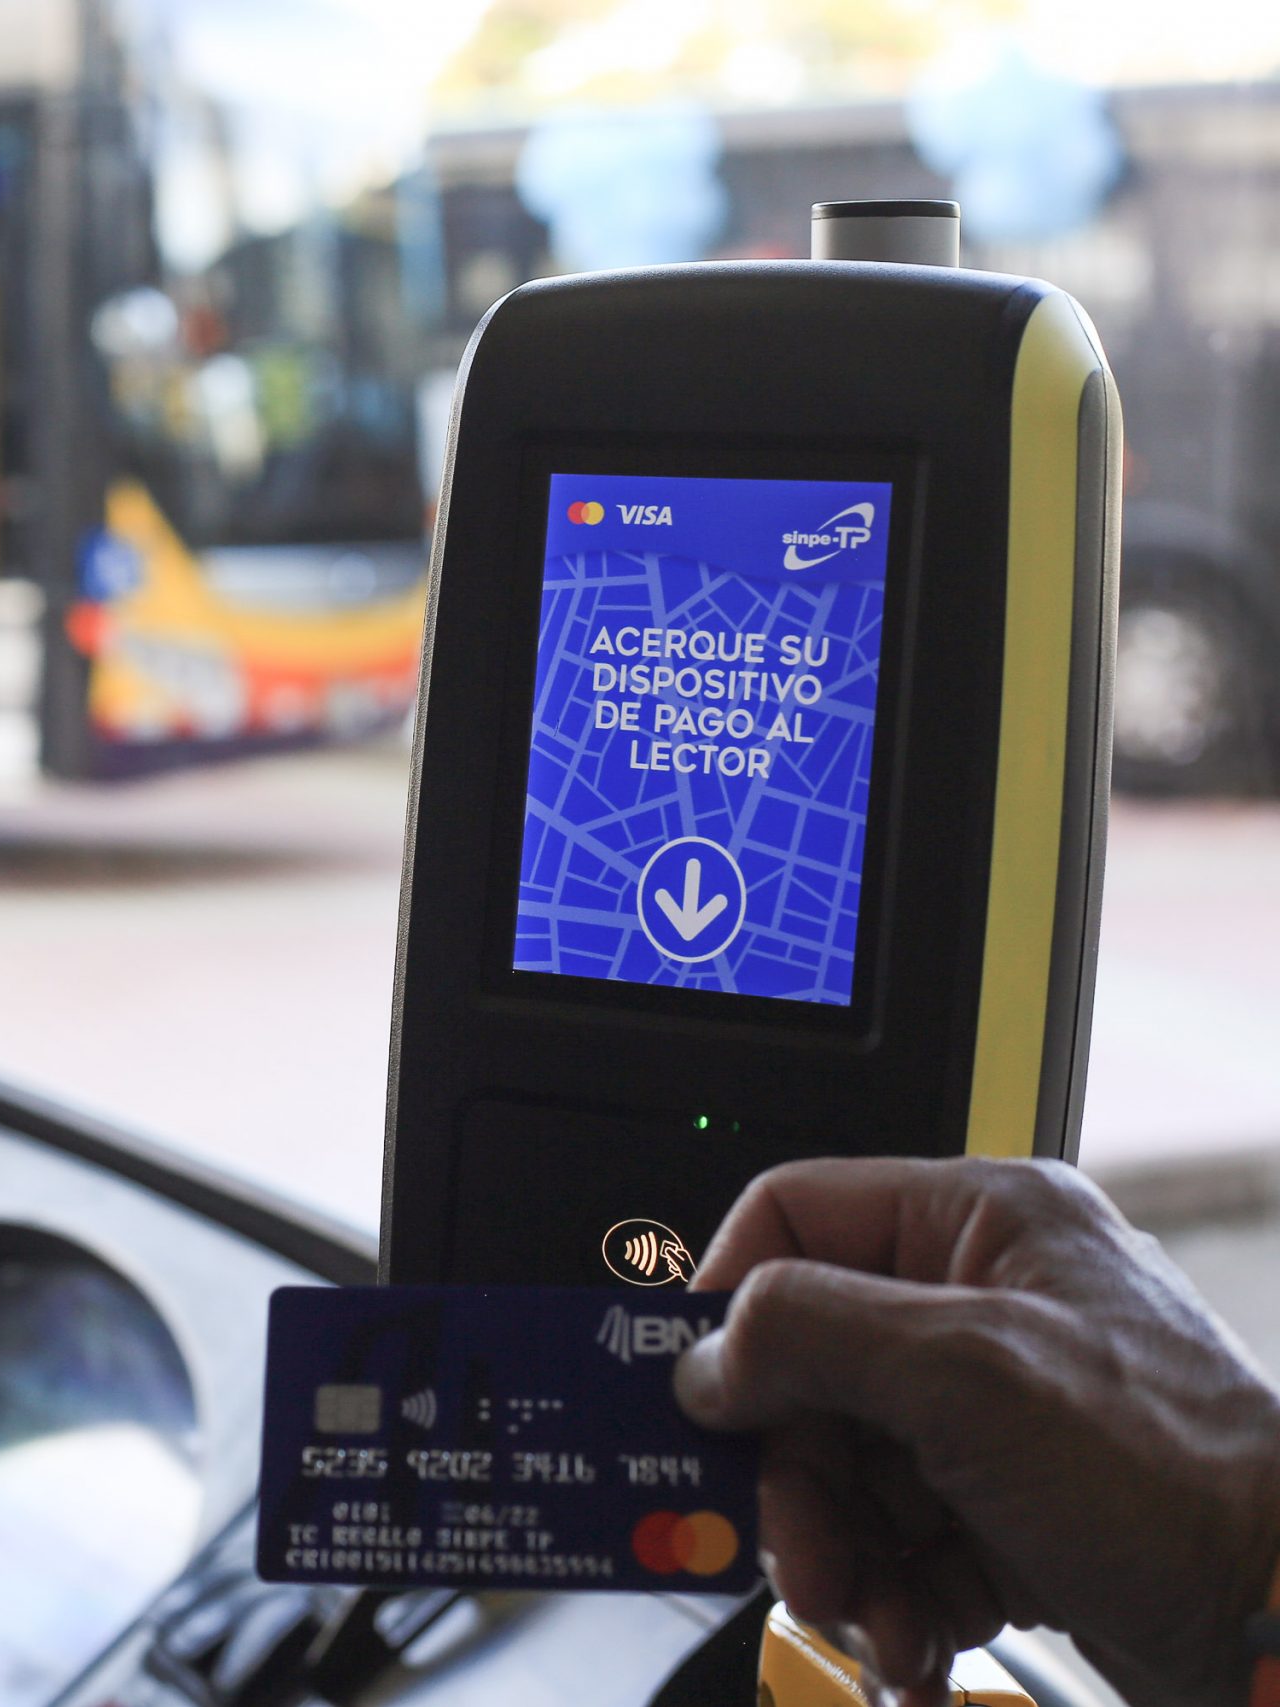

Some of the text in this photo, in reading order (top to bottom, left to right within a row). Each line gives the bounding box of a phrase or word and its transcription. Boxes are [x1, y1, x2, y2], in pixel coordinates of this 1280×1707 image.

[616, 504, 673, 526] VISA
[590, 626, 829, 667] ACERQUE SU
[592, 663, 822, 705] DISPOSITIVO
[594, 701, 814, 743] DE PAGO AL
[629, 740, 771, 779] LECTOR
[302, 1447, 388, 1478] 5235
[406, 1451, 492, 1482] 9202
[617, 1454, 702, 1487] 7844
